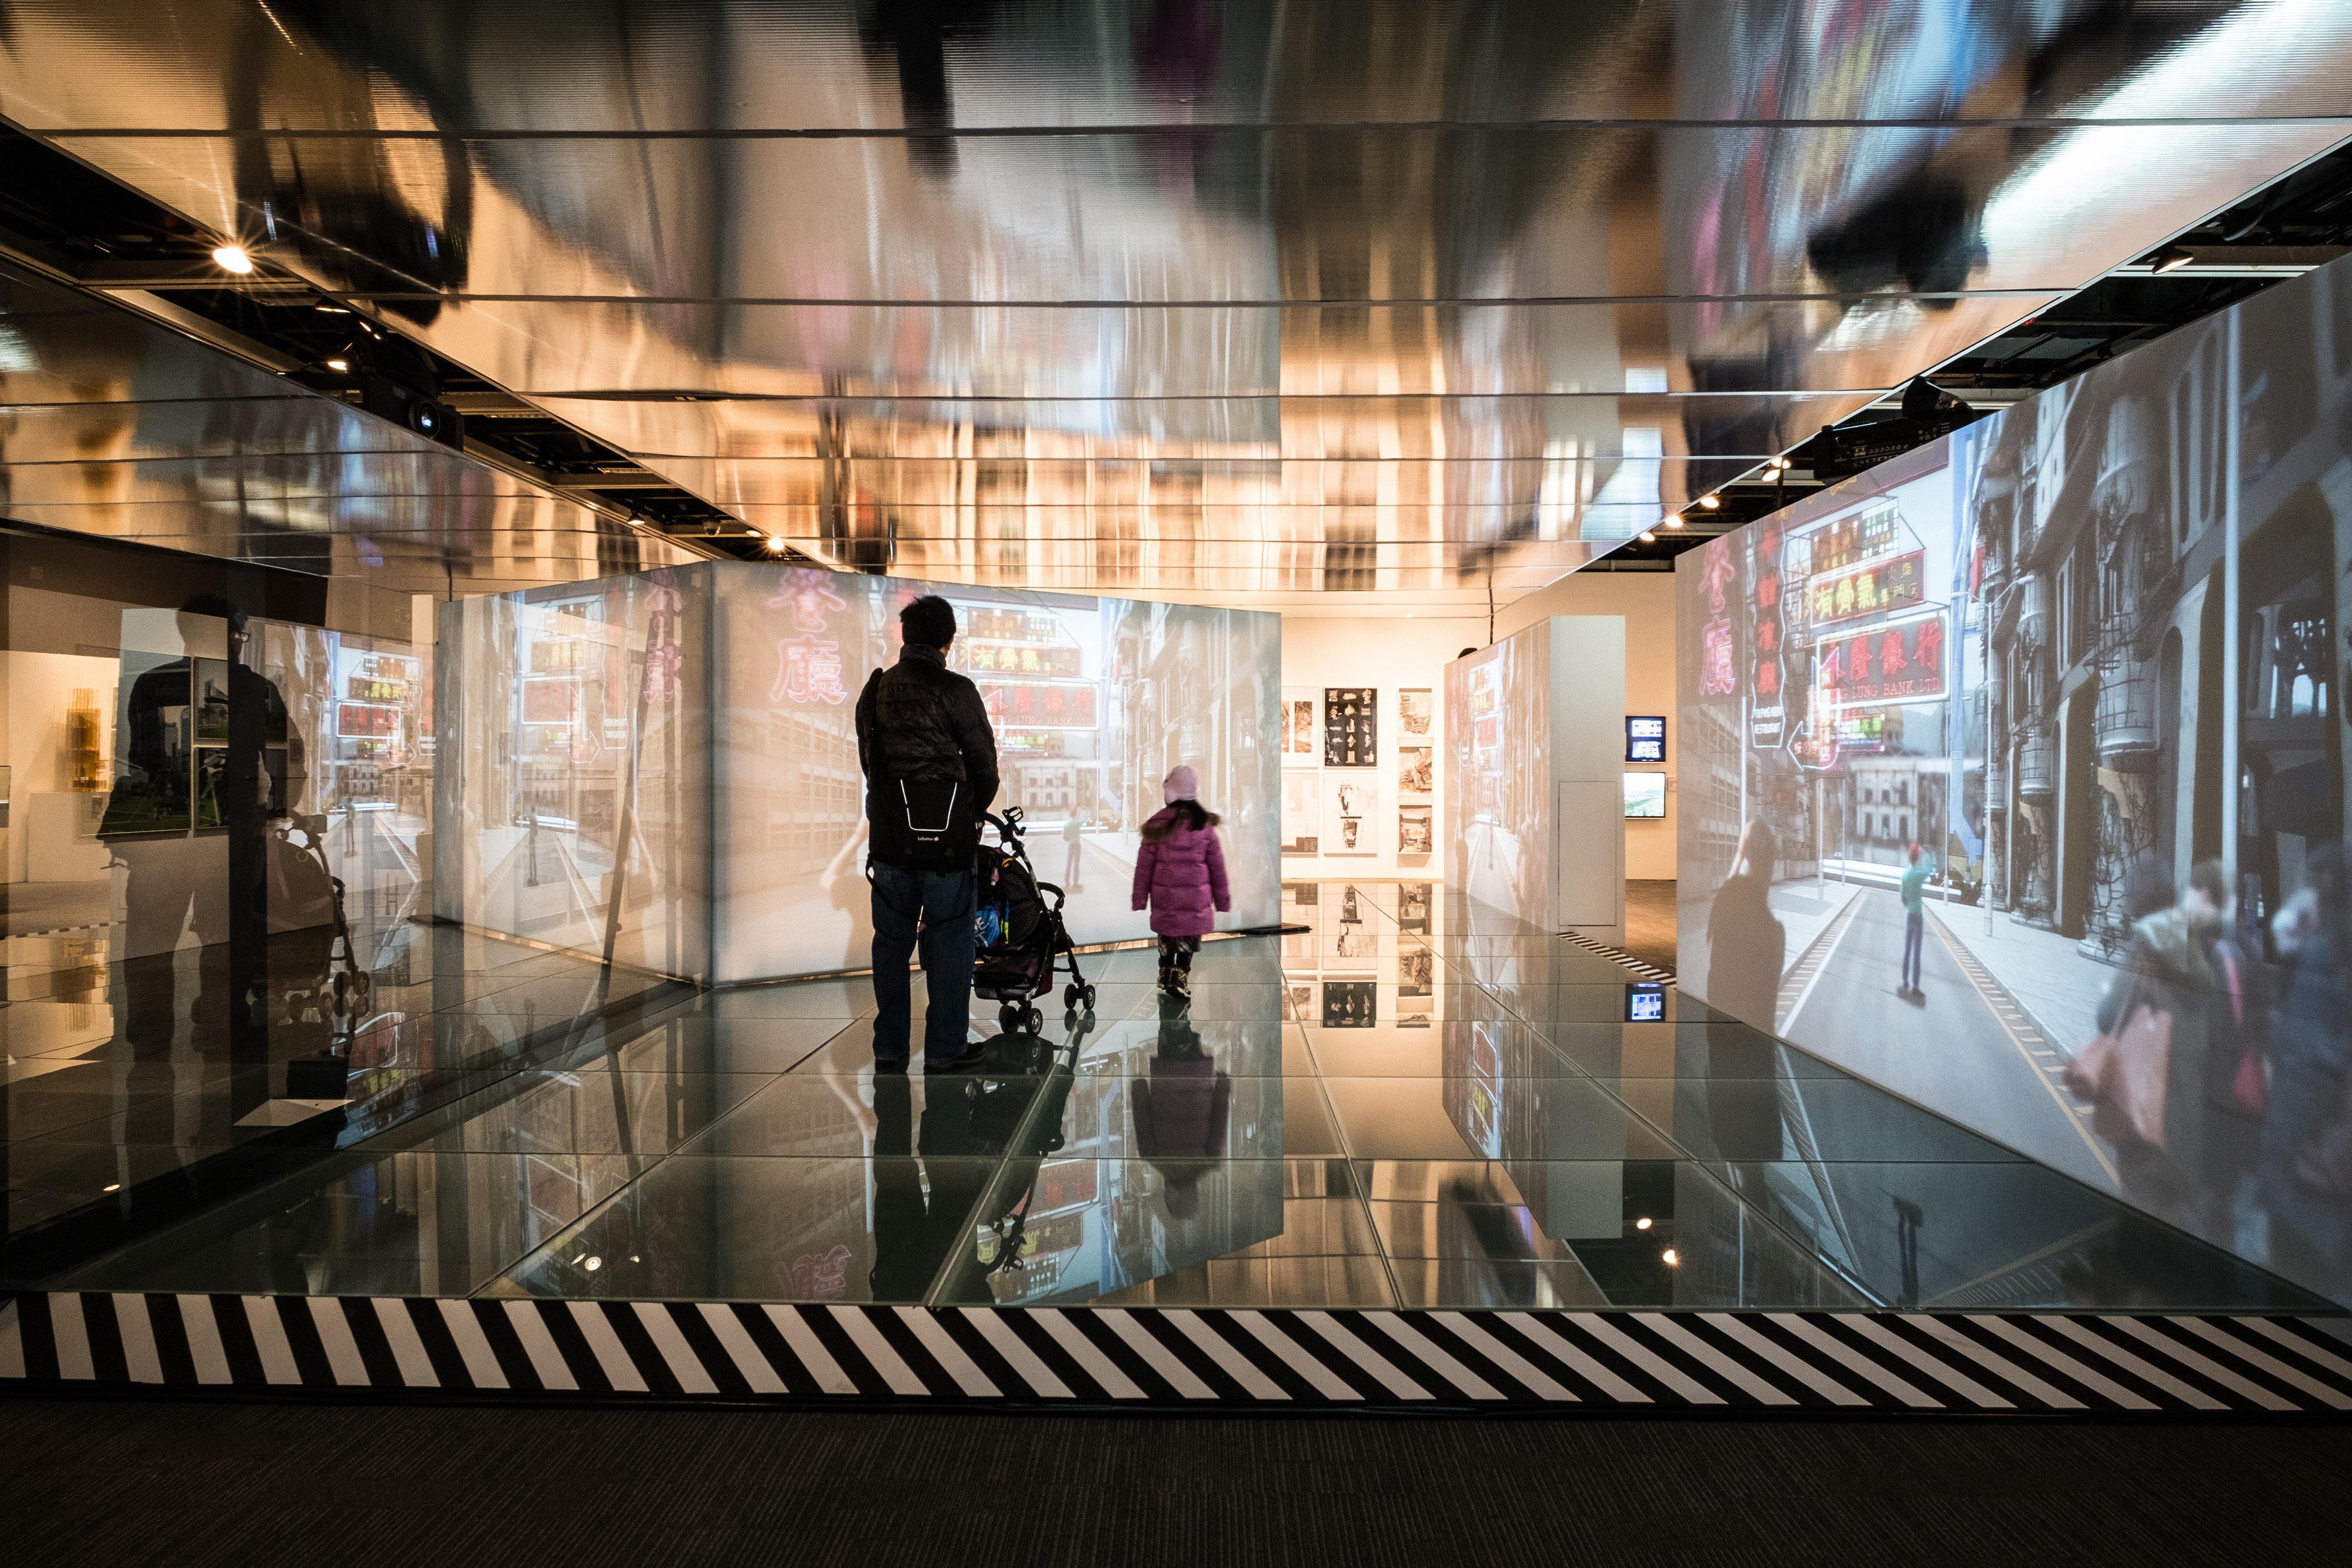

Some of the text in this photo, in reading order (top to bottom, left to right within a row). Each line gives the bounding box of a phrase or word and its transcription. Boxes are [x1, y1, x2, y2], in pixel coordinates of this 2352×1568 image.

[1815, 574, 1877, 620] 有骨氣
[974, 647, 1040, 671] 有骨氣
[1852, 684, 1879, 699] LUNG
[1883, 680, 1914, 696] BANK
[1016, 716, 1041, 724] LUNG
[1047, 716, 1073, 725] BANK
